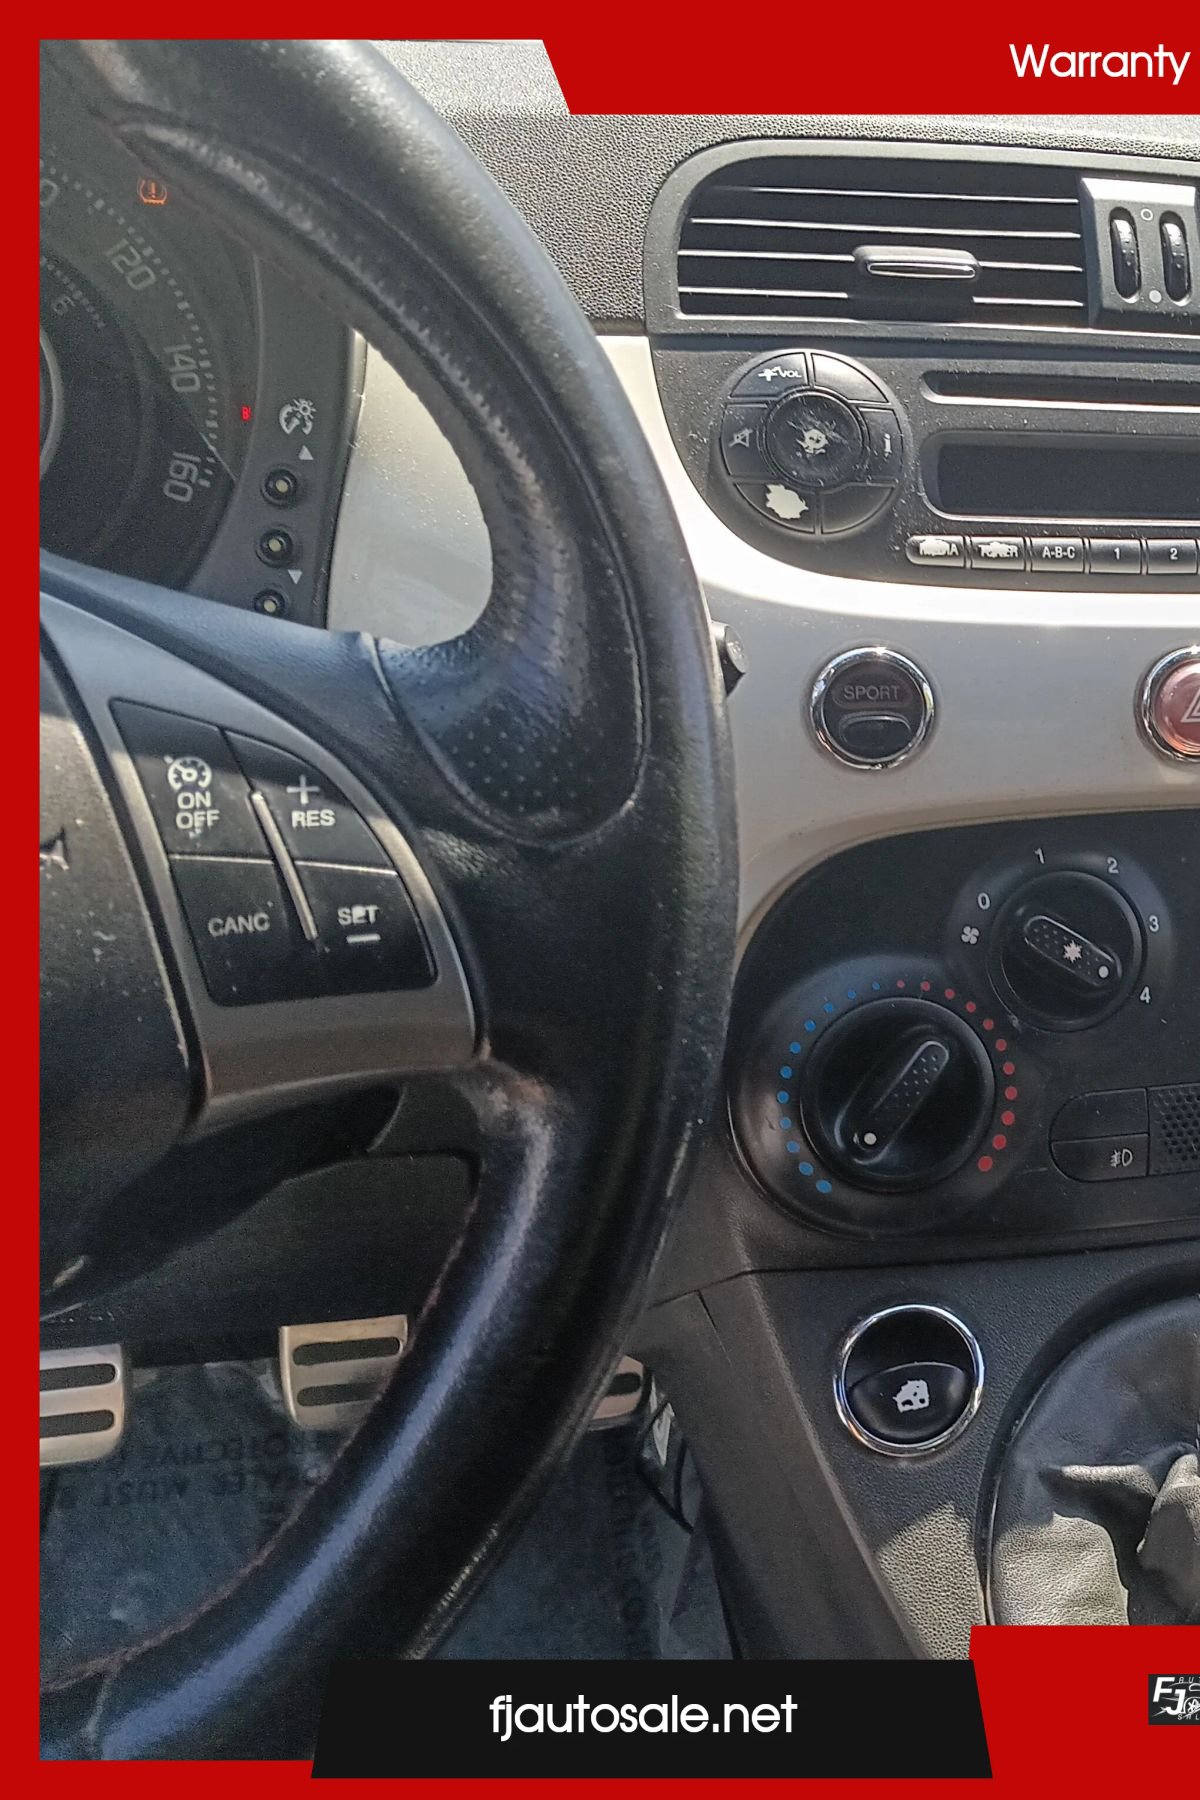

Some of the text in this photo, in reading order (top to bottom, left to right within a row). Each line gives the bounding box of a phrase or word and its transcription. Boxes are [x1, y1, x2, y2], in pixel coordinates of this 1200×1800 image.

[103, 238, 157, 291] 120
[162, 343, 201, 393] 140
[162, 451, 202, 503] 160
[1041, 545, 1076, 560] A-B-C
[1113, 547, 1121, 560] 1
[1169, 547, 1179, 561] 2
[843, 684, 900, 701] SPORT
[177, 791, 212, 810] ON
[175, 809, 221, 830] OFF
[291, 809, 337, 829] RES
[1034, 847, 1045, 865] 1
[1106, 856, 1120, 875] 2
[977, 892, 991, 910] 0
[207, 912, 271, 937] CANC
[337, 904, 380, 928] SET
[1148, 914, 1160, 933] 3
[1139, 986, 1152, 1004] 4
